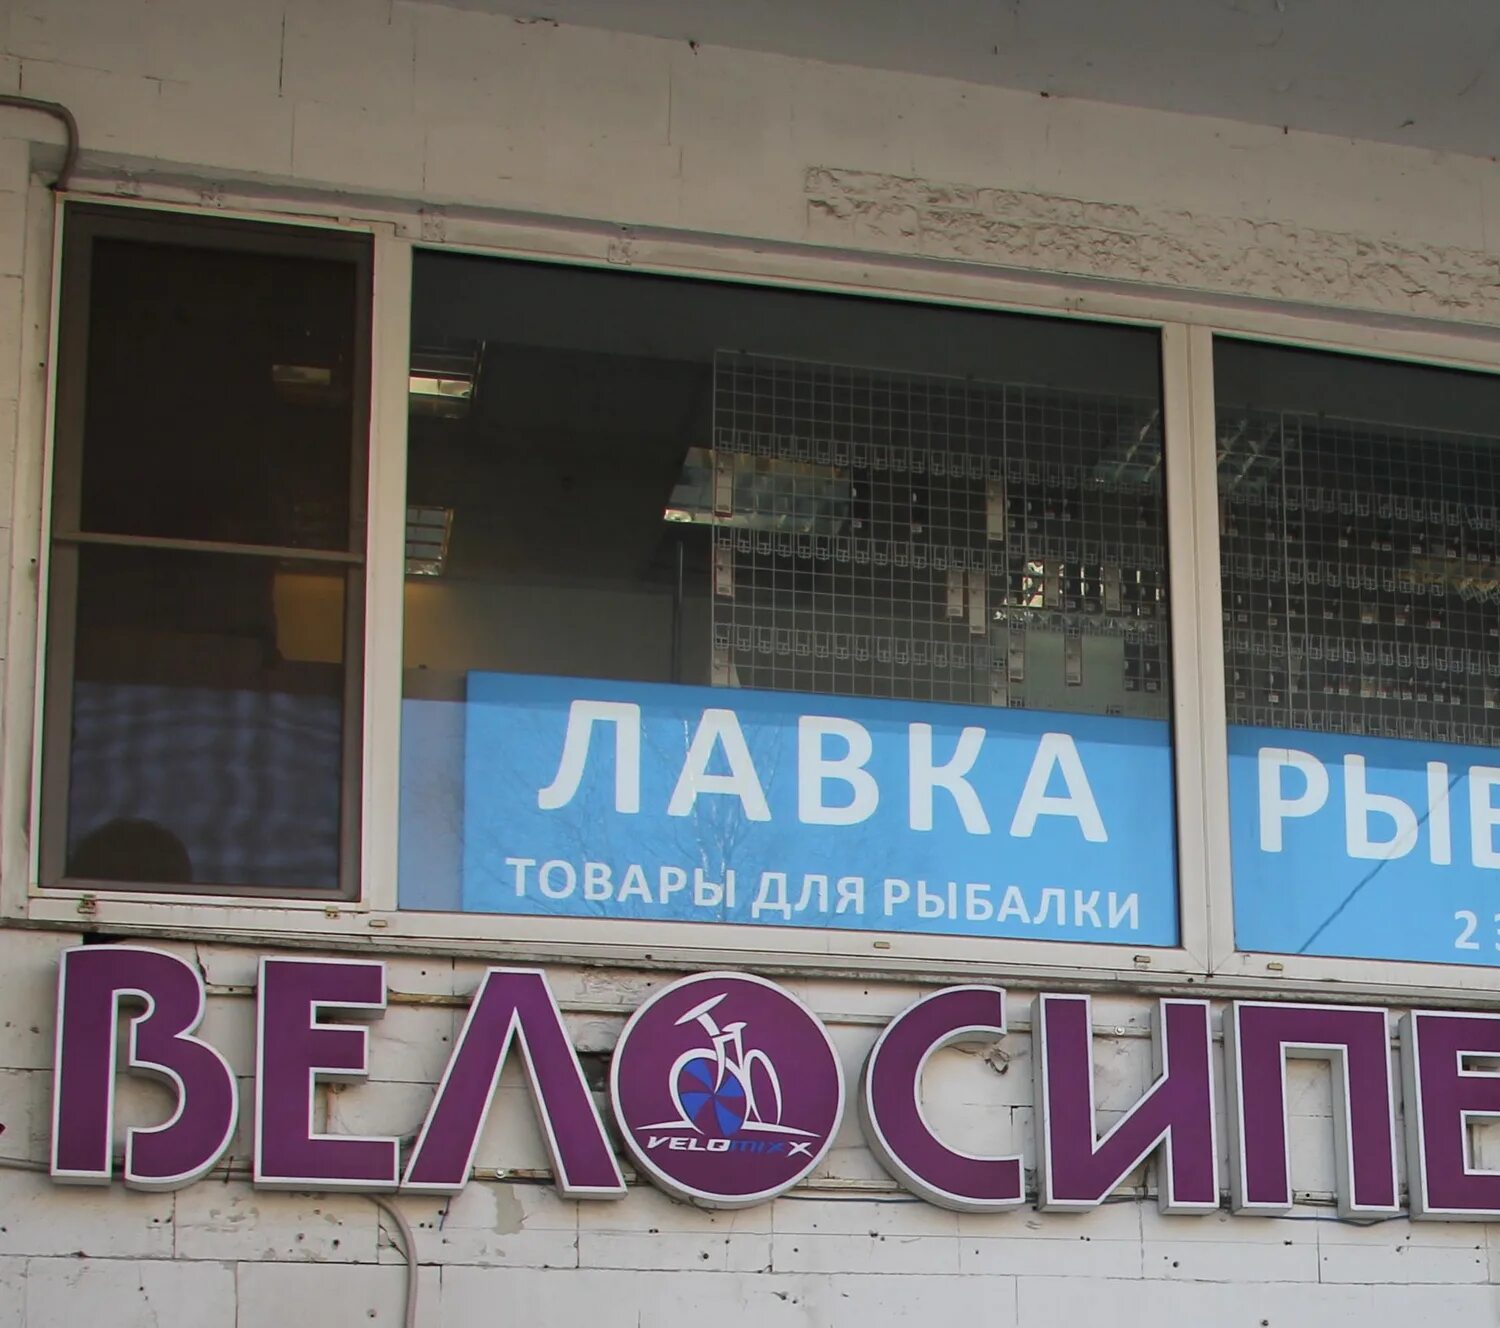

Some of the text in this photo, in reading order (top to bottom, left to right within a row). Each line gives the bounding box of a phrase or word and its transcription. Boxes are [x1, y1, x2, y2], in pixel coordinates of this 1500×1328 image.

[537, 700, 1109, 842] ЛАВКА
[506, 857, 1140, 930] ТОВАРЫ ДЛЯ РЫБАЛКИ
[1454, 909, 1480, 950] 2
